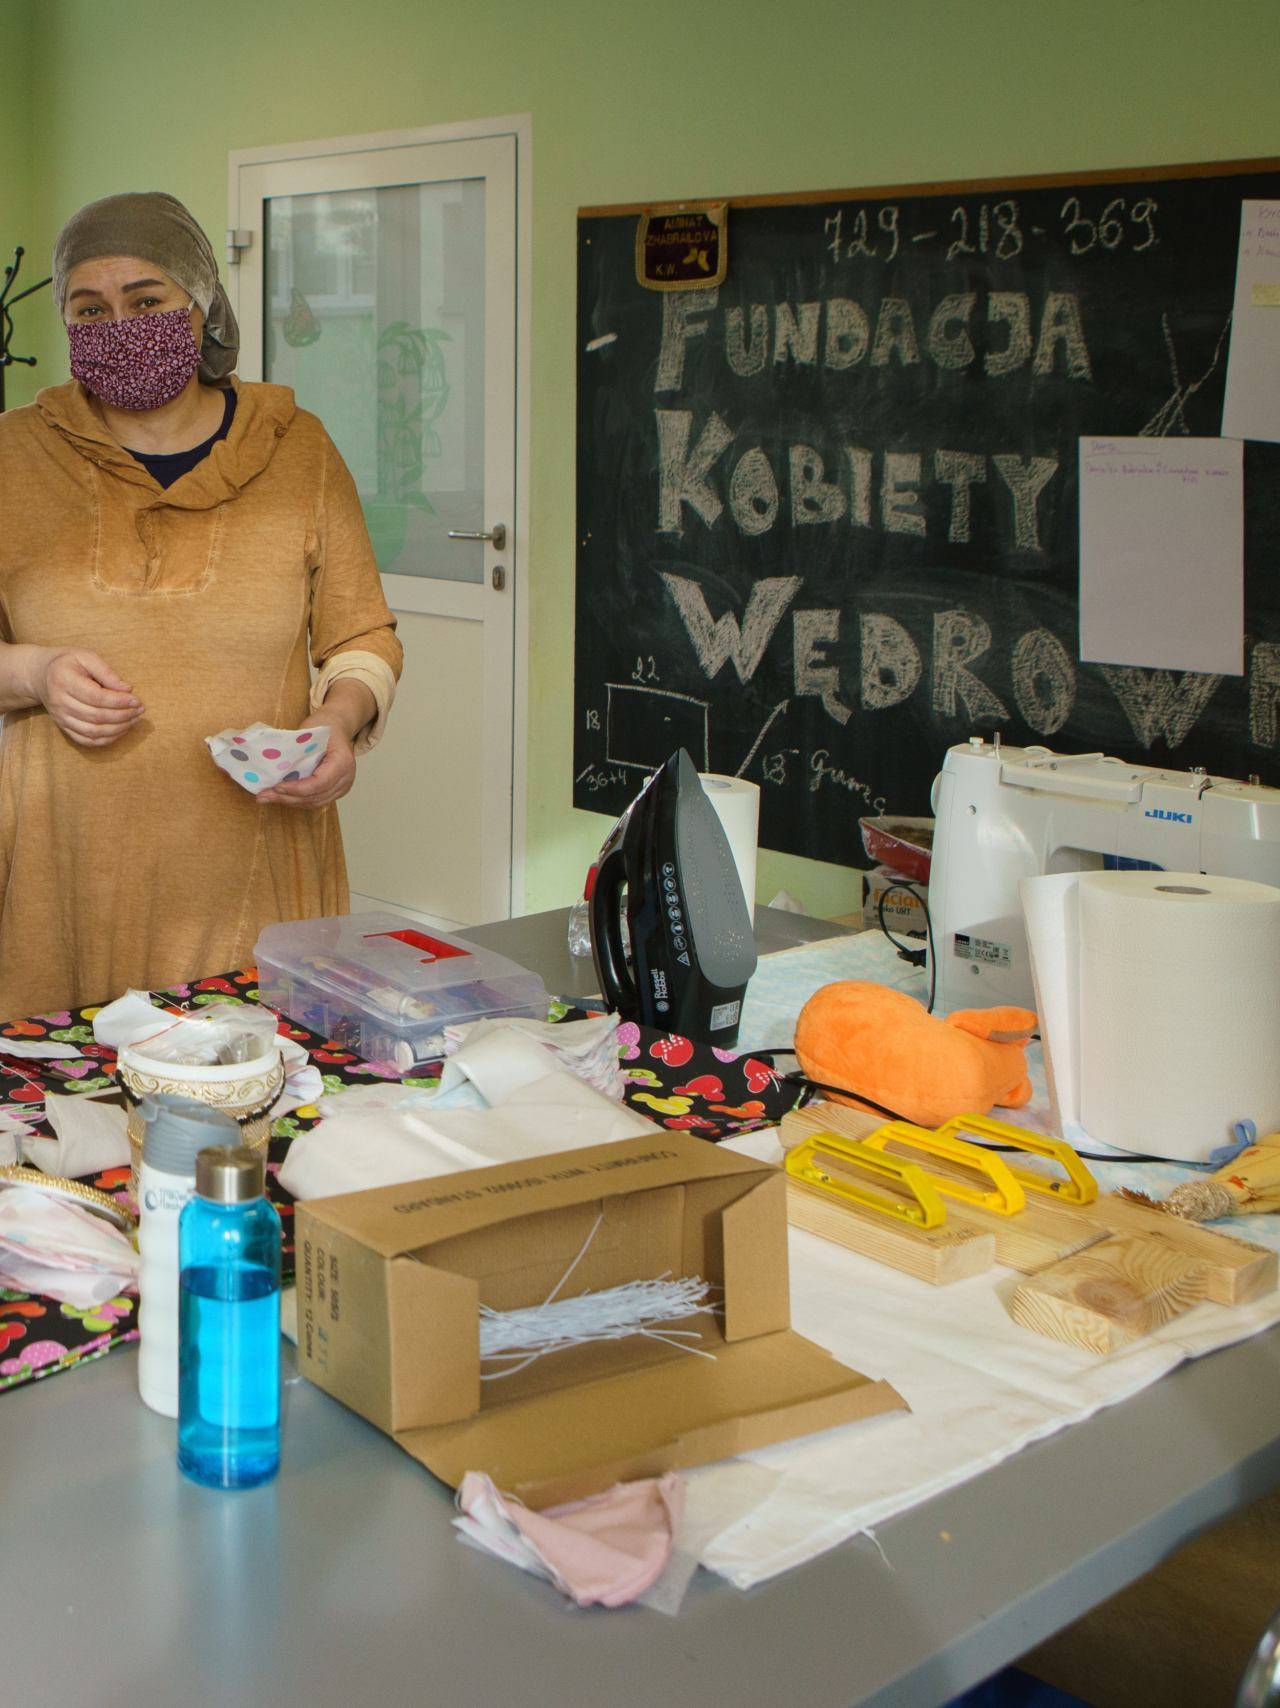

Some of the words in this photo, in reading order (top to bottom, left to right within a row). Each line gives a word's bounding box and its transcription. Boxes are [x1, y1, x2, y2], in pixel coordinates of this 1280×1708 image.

[654, 287, 1094, 392] FUNDACJA
[655, 408, 1060, 552] KOBIETY
[586, 709, 601, 731] 18
[1145, 809, 1193, 824] JUKI
[650, 968, 661, 999] Russell
[658, 970, 669, 999] Hobbs
